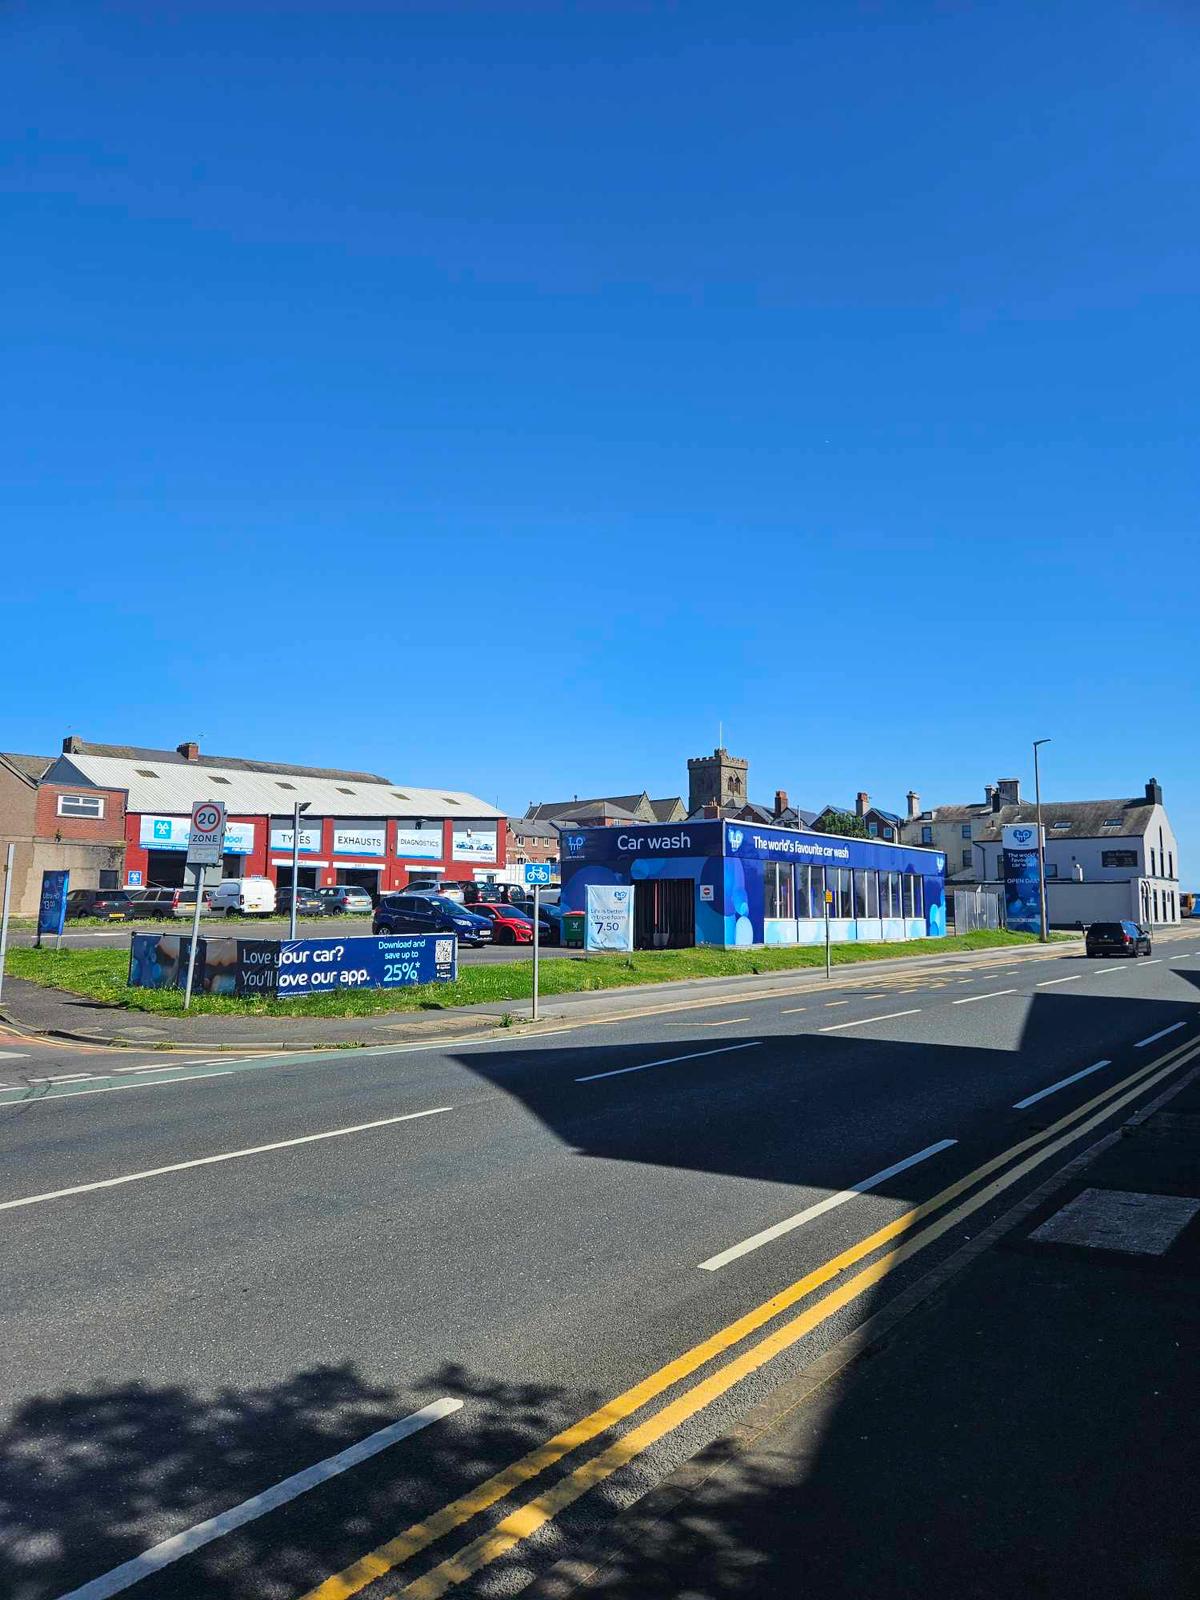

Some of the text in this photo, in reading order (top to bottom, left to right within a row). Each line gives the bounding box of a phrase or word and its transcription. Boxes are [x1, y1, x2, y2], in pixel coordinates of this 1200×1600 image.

[198, 812, 217, 825] 20
[192, 834, 218, 843] ZONE
[282, 834, 311, 844] TYES
[337, 836, 382, 847] EXHAUSTS
[400, 838, 439, 848] DIAGNOSTICS
[617, 832, 691, 850] Car wash
[753, 836, 849, 859] The world's favourite car wash
[378, 939, 426, 950] Download and
[242, 946, 344, 968] Love your car?
[384, 952, 400, 960] save
[401, 952, 410, 960] up
[241, 969, 370, 987] You'll love our app.
